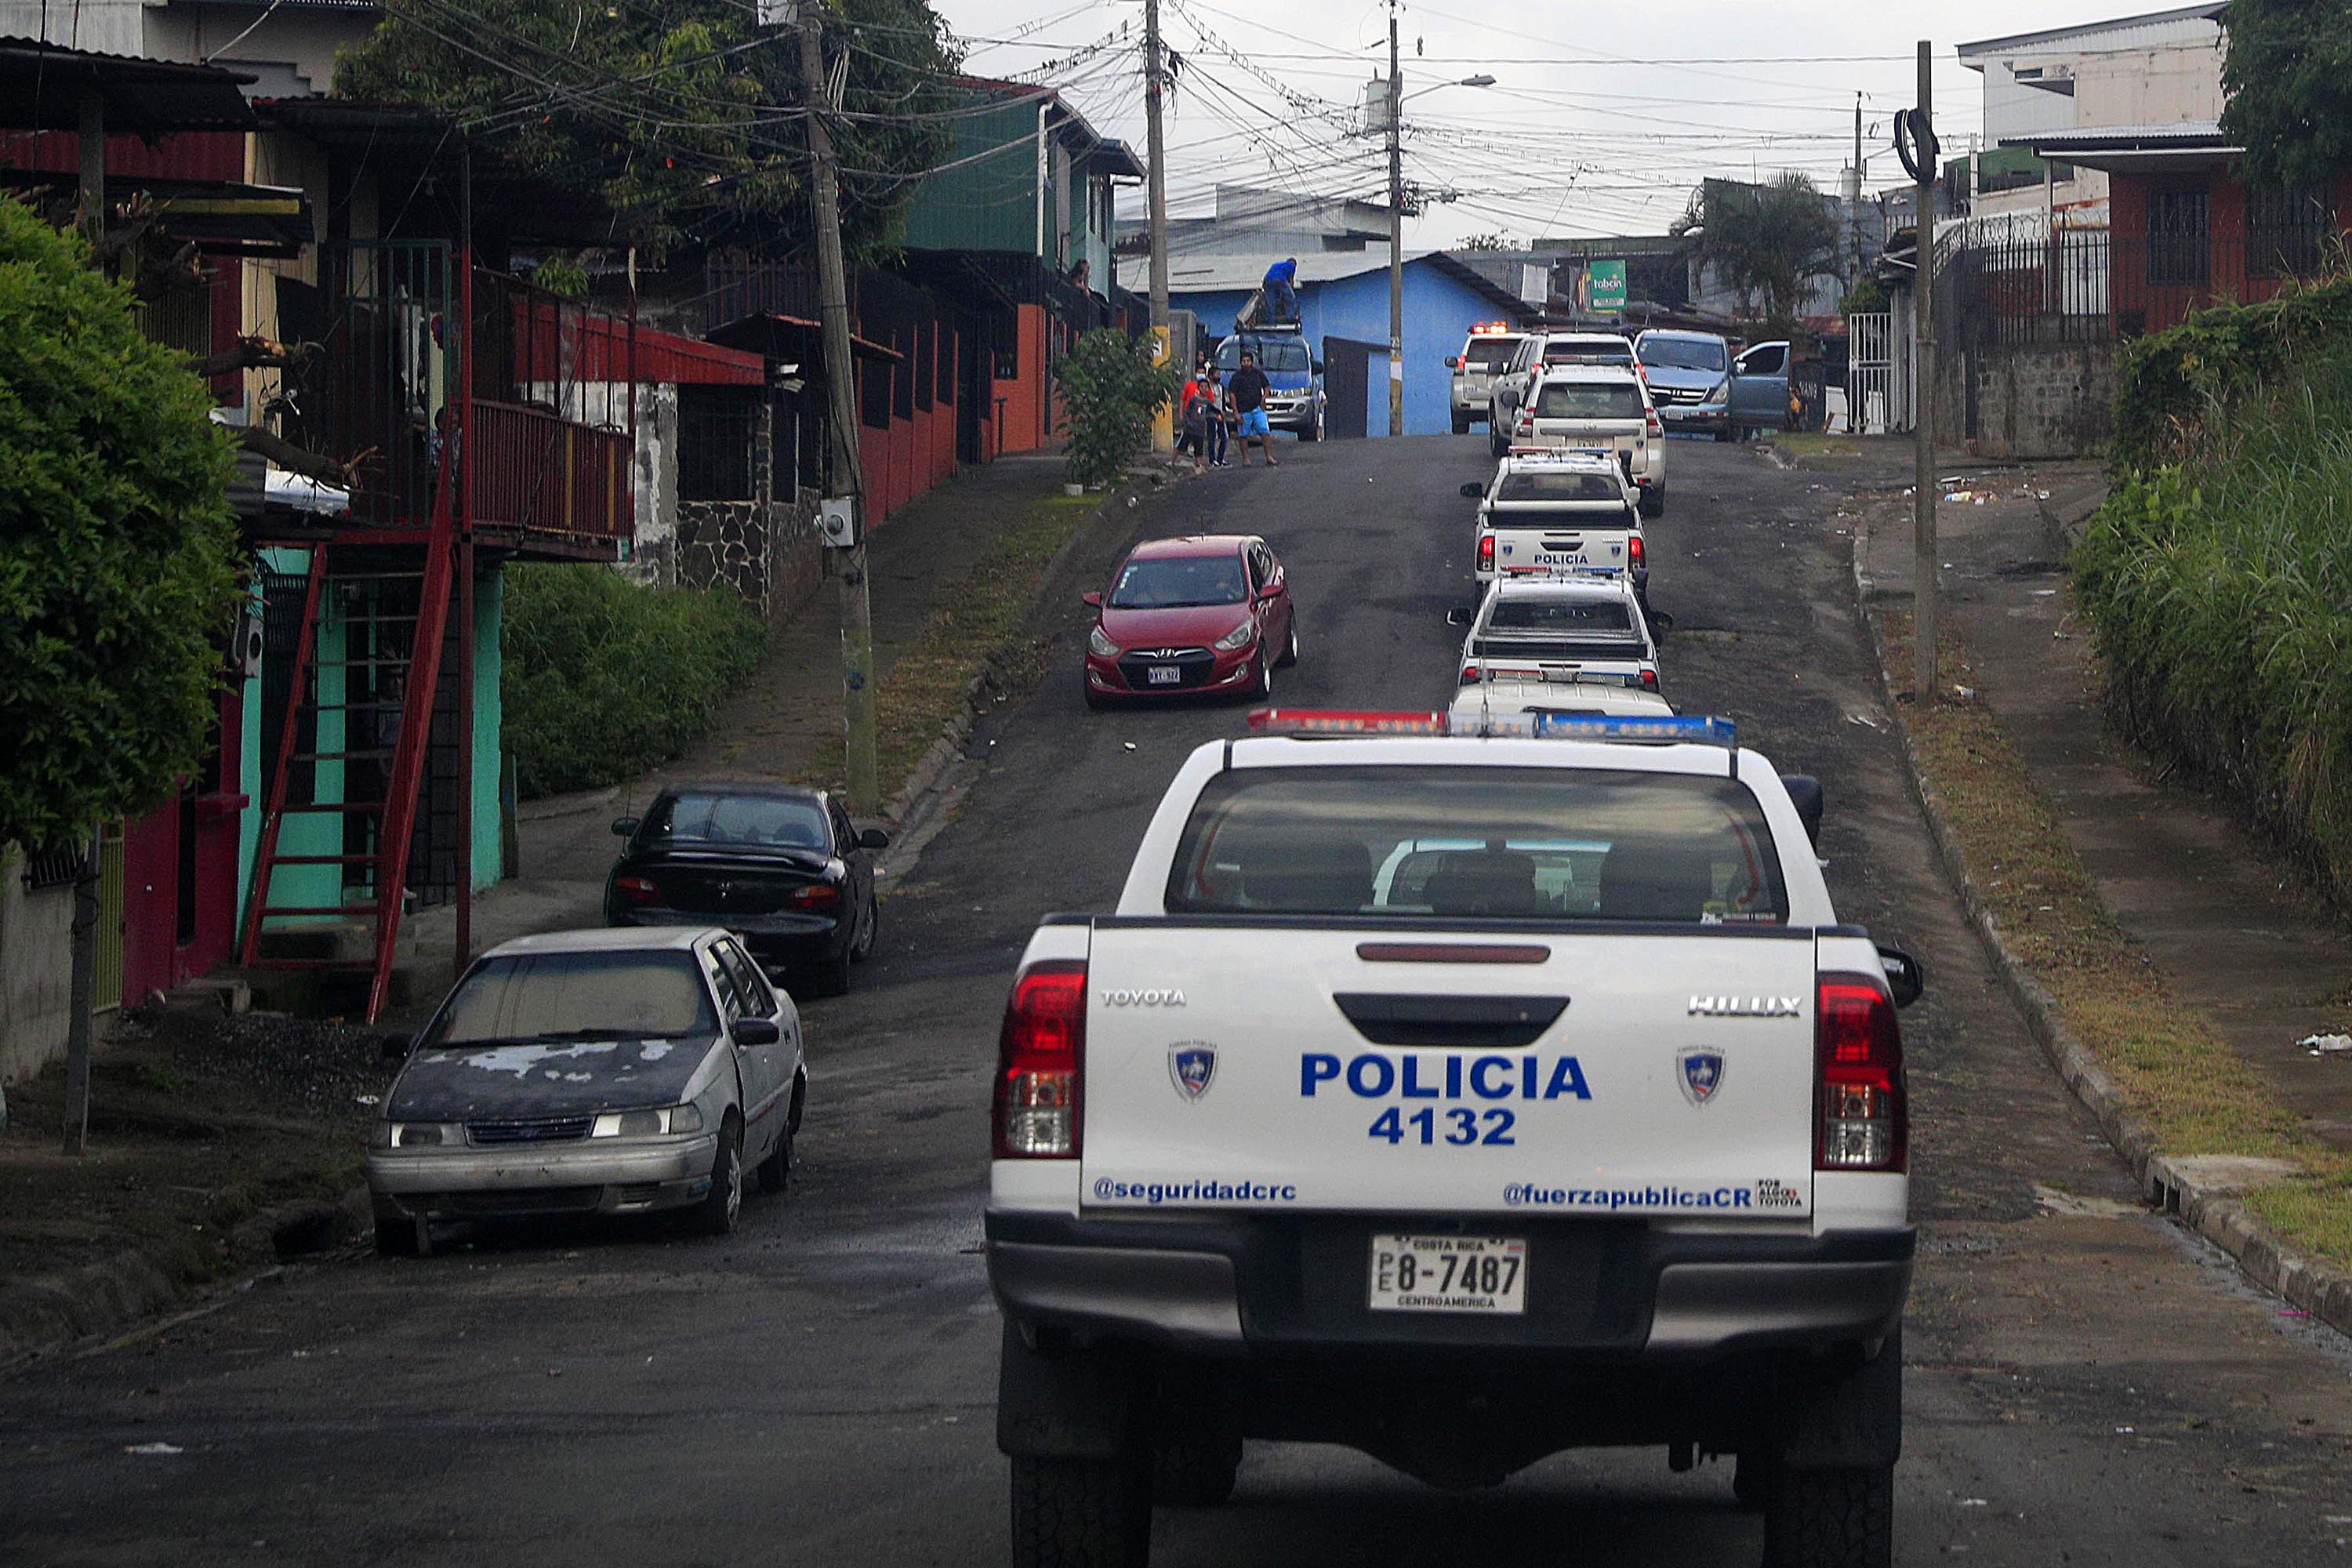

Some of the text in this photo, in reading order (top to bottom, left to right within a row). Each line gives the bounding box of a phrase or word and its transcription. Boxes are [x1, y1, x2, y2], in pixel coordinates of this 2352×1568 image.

[1534, 554, 1588, 564] POLICIA
[1102, 989, 1186, 1007] TOYOTA
[1688, 996, 1801, 1017] HILUX
[1300, 1053, 1593, 1100] POLICIA
[1368, 1106, 1516, 1145] 4132
[1094, 1177, 1297, 1204] @seguridadcrc
[1503, 1182, 1752, 1209] @fuerzapublicaCR
[1759, 1198, 1802, 1207] TOYOTA
[1413, 1240, 1485, 1252] COSTA RICA
[1398, 1254, 1521, 1296] 8-7487
[1398, 1296, 1496, 1308] CENTROAMERICA
